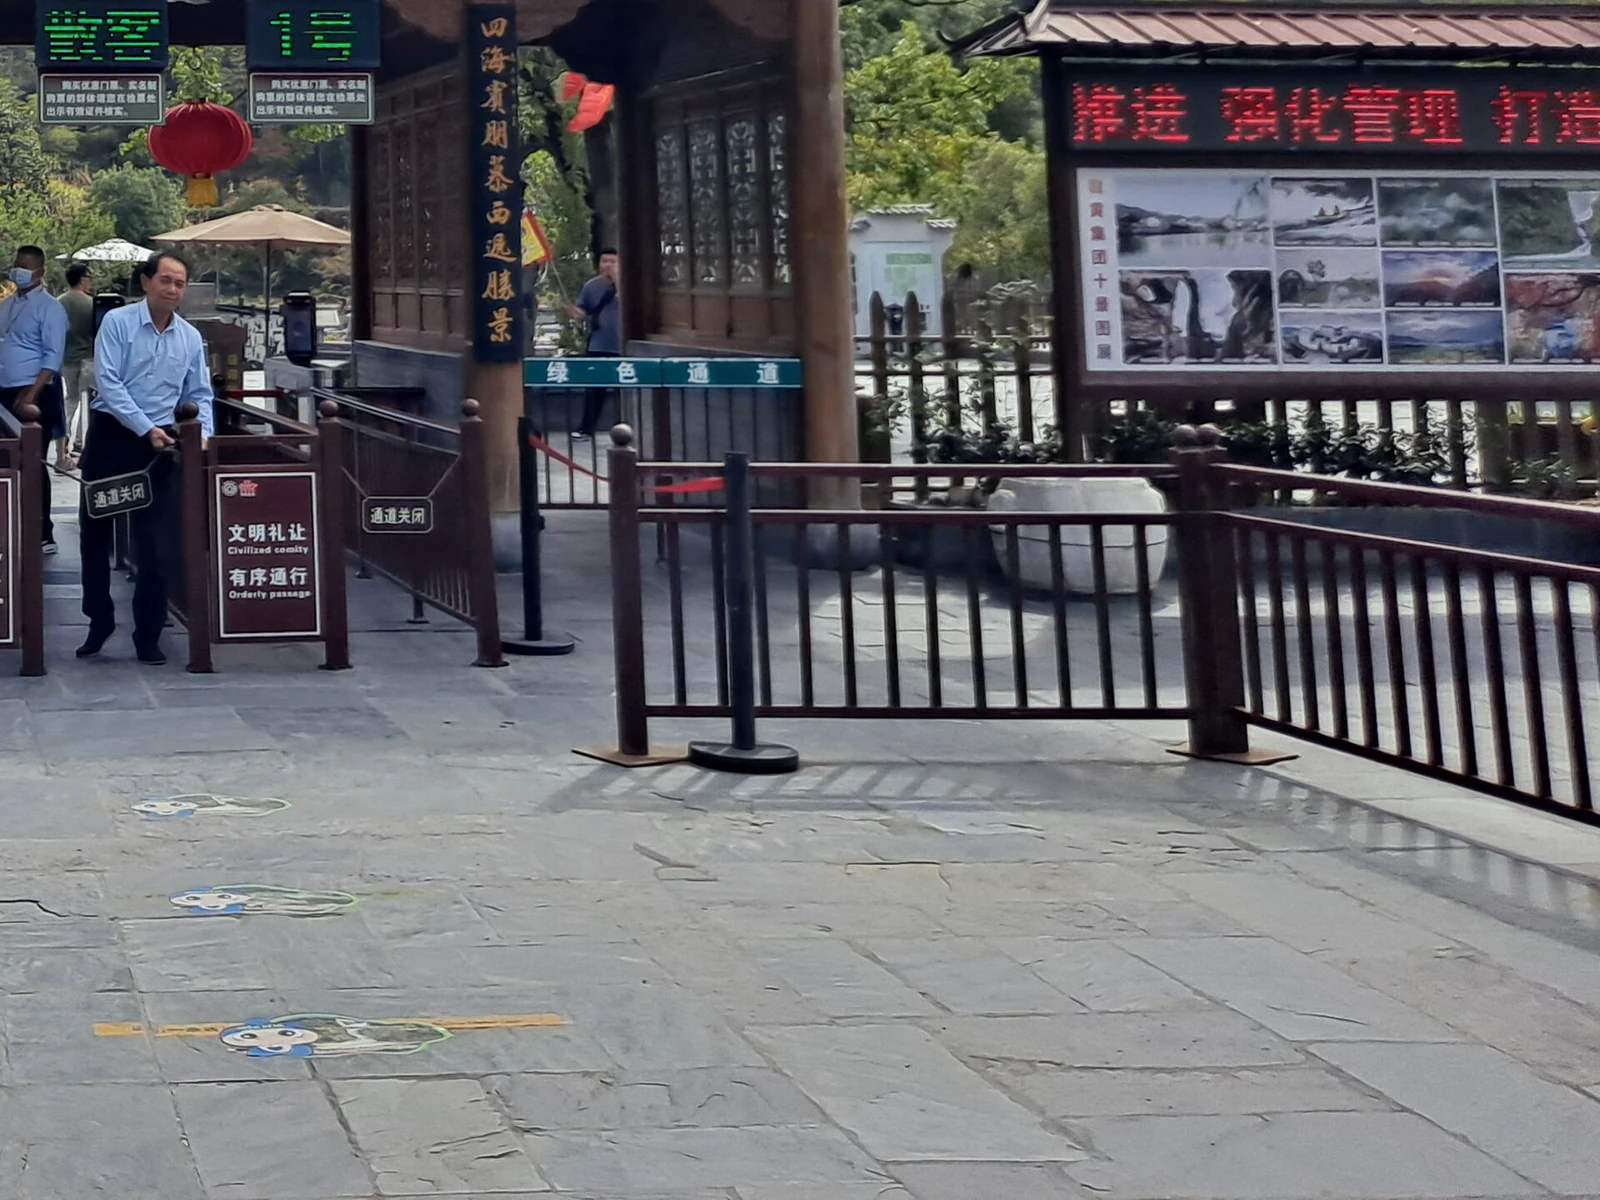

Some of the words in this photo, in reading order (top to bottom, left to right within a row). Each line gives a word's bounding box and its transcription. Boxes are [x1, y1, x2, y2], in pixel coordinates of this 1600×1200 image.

[44, 10, 160, 61] 散客
[269, 11, 358, 62] 1号
[1072, 81, 1190, 143] 推进
[1220, 84, 1464, 145] 强化管理
[1492, 83, 1600, 146] 打造
[546, 361, 781, 385] 绿色通道
[92, 482, 146, 510] 通道关闭
[369, 506, 426, 525] 通道关闭
[227, 523, 308, 543] 文明礼让
[227, 545, 272, 555] Civilized
[274, 545, 309, 556] comity
[228, 567, 309, 587] 有序通行
[228, 590, 267, 600] Orderly
[269, 590, 311, 600] passage
